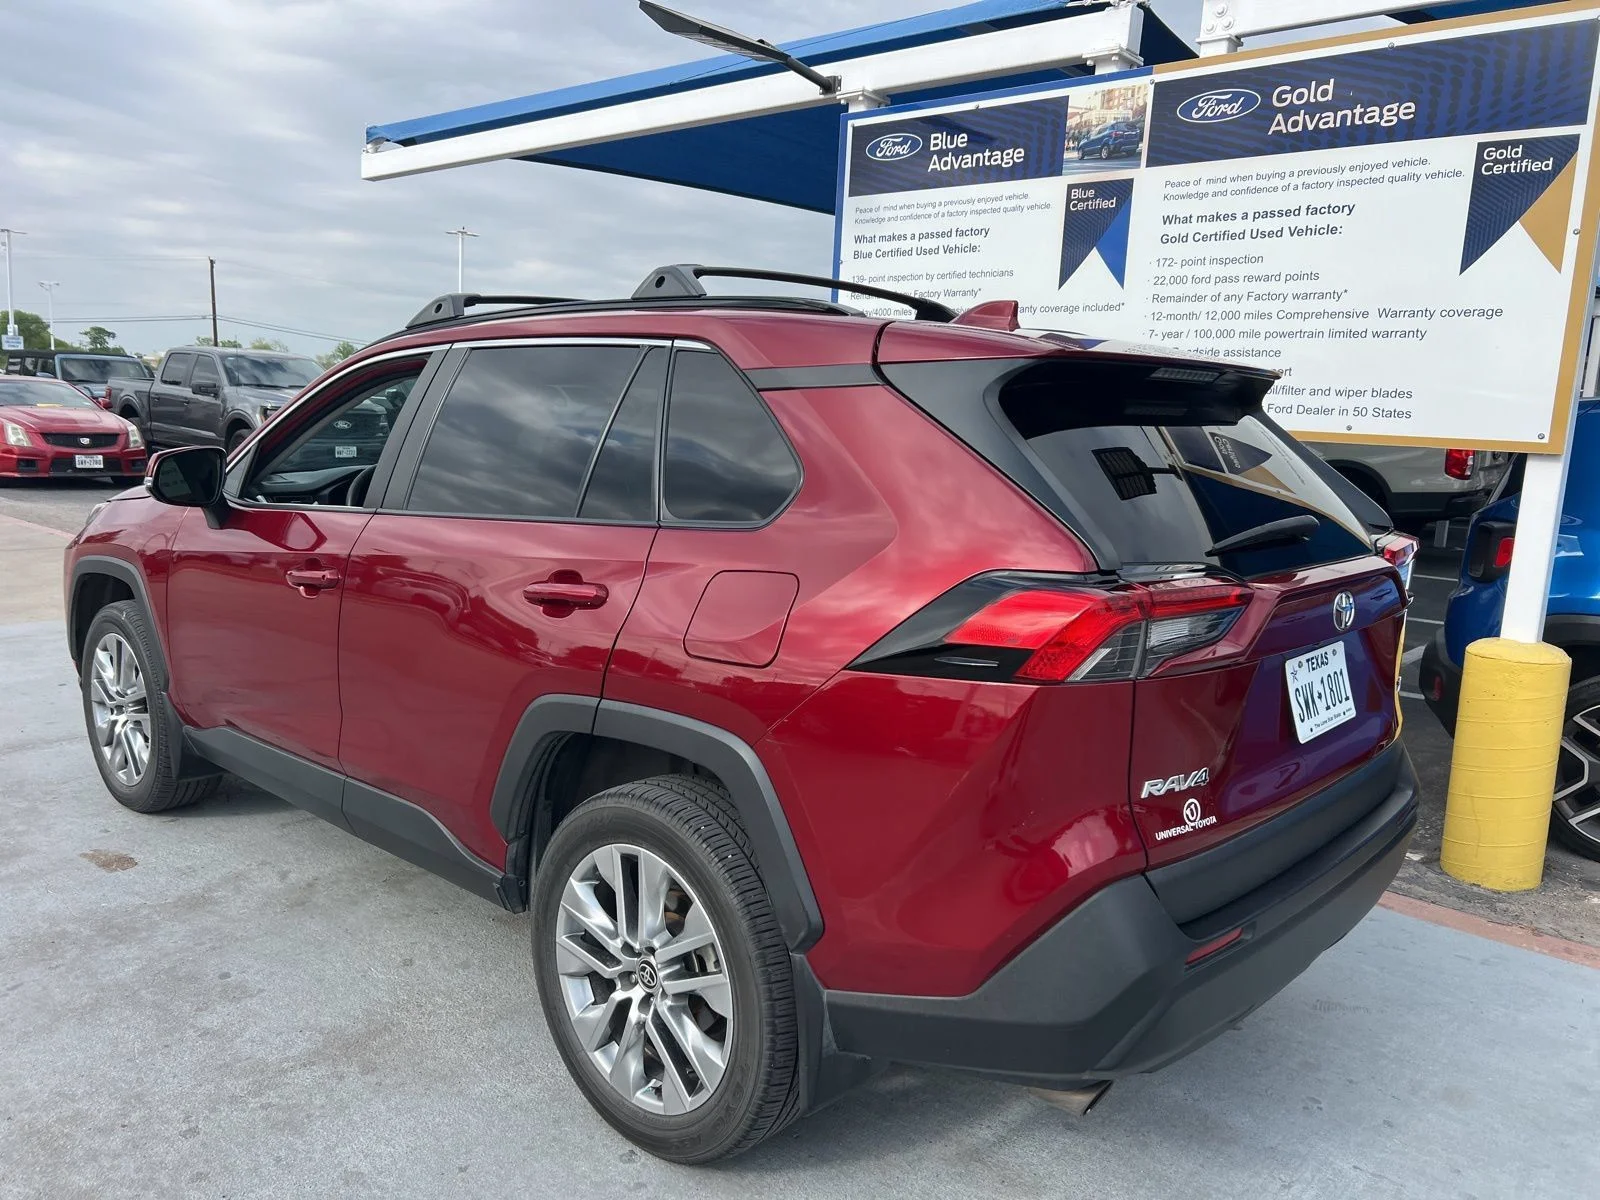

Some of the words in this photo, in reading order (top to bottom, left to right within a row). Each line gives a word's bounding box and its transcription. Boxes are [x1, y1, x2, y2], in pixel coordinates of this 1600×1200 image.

[1272, 78, 1334, 107] Gold
[1192, 94, 1244, 119] Ford
[1268, 102, 1416, 136] Advantage
[876, 137, 912, 157] Ford
[930, 132, 968, 150] Blue
[928, 148, 1024, 172] Advantage
[1483, 144, 1522, 160] Gold
[1164, 180, 1190, 189] Peace
[1192, 178, 1202, 186] of
[1206, 176, 1227, 185] mind
[1230, 173, 1253, 183] when
[1256, 170, 1286, 181] buying
[1297, 164, 1346, 177] previously
[1349, 161, 1389, 173] enjoyed
[1392, 156, 1431, 168] vehicle.
[1481, 158, 1554, 176] Certified
[1163, 190, 1209, 201] Knowledge
[1212, 188, 1228, 198] and
[1230, 184, 1279, 196] confidence
[1281, 182, 1292, 192] of
[1302, 178, 1334, 190] factory
[1336, 175, 1385, 188] inspected
[1388, 172, 1422, 184] quality
[1424, 168, 1465, 180] vehicle.
[1071, 188, 1094, 199] Blue
[883, 204, 897, 212] mind
[916, 200, 936, 209] buying
[944, 198, 976, 207] previously
[978, 194, 1004, 204] enjoyed
[1070, 197, 1116, 210] Certified
[855, 216, 885, 224] Knowledge
[900, 213, 932, 221] confidence
[947, 209, 968, 218] factory
[970, 206, 1000, 216] inspected
[1003, 204, 1025, 213] quality
[1162, 214, 1193, 225] What
[1196, 211, 1237, 223] makes
[1241, 212, 1248, 220] a
[1252, 206, 1301, 222] passed
[1305, 202, 1356, 216] factory
[854, 234, 876, 244] What
[879, 232, 907, 242] makes
[918, 228, 952, 242] passed
[956, 227, 990, 238] factory
[1160, 232, 1189, 244] Gold
[1192, 229, 1246, 243] Certified
[1250, 226, 1283, 240] Used
[1288, 223, 1343, 237] Vehicle:
[854, 250, 872, 259] Blue
[875, 247, 912, 258] Certified
[916, 245, 939, 256] Used
[942, 243, 980, 254] Vehicle:
[1156, 258, 1178, 267] 172-
[1180, 256, 1206, 268] point
[1209, 254, 1264, 267] inspection
[869, 274, 886, 283] point
[887, 273, 923, 283] inspection
[925, 272, 934, 281] by
[937, 270, 966, 280] certified
[969, 269, 1014, 278] technicians
[1153, 275, 1188, 286] 22,000
[1191, 274, 1211, 285] ford
[1214, 275, 1240, 286] pass
[1243, 272, 1282, 283] reward
[1285, 271, 1320, 283] points
[914, 290, 941, 299] Factory
[1151, 292, 1208, 304] Remainder
[1210, 292, 1222, 302] of
[1224, 293, 1243, 304] any
[1246, 291, 1288, 303] Factory
[894, 308, 912, 316] miles
[1039, 303, 1080, 314] coverage
[1150, 310, 1202, 321] 12-month/
[1205, 310, 1240, 322] 12,000
[1244, 310, 1273, 320] miles
[1276, 308, 1369, 322] Comprehensive
[1377, 307, 1436, 320] Warranty
[1440, 307, 1503, 320] coverage
[1149, 329, 1158, 339] 7-
[1161, 330, 1183, 341] year
[1194, 328, 1235, 340] 100,000
[1238, 328, 1261, 339] mile
[1264, 328, 1324, 341] powertrain
[1328, 328, 1367, 339] limited
[1371, 328, 1427, 341] warranty
[1223, 349, 1281, 358] assistance
[1309, 386, 1331, 396] and
[1335, 388, 1368, 399] wiper
[1371, 387, 1413, 399] blades
[1267, 404, 1293, 414] Ford
[1297, 405, 1335, 416] Dealer
[1338, 406, 1349, 416] in
[1352, 407, 1368, 417] 50
[1372, 407, 1412, 419] States
[1306, 652, 1329, 672] TEXAS
[1141, 767, 1209, 798] RAV4
[1155, 825, 1193, 840] UNIVERSAL
[1195, 816, 1217, 829] TOYOTA
